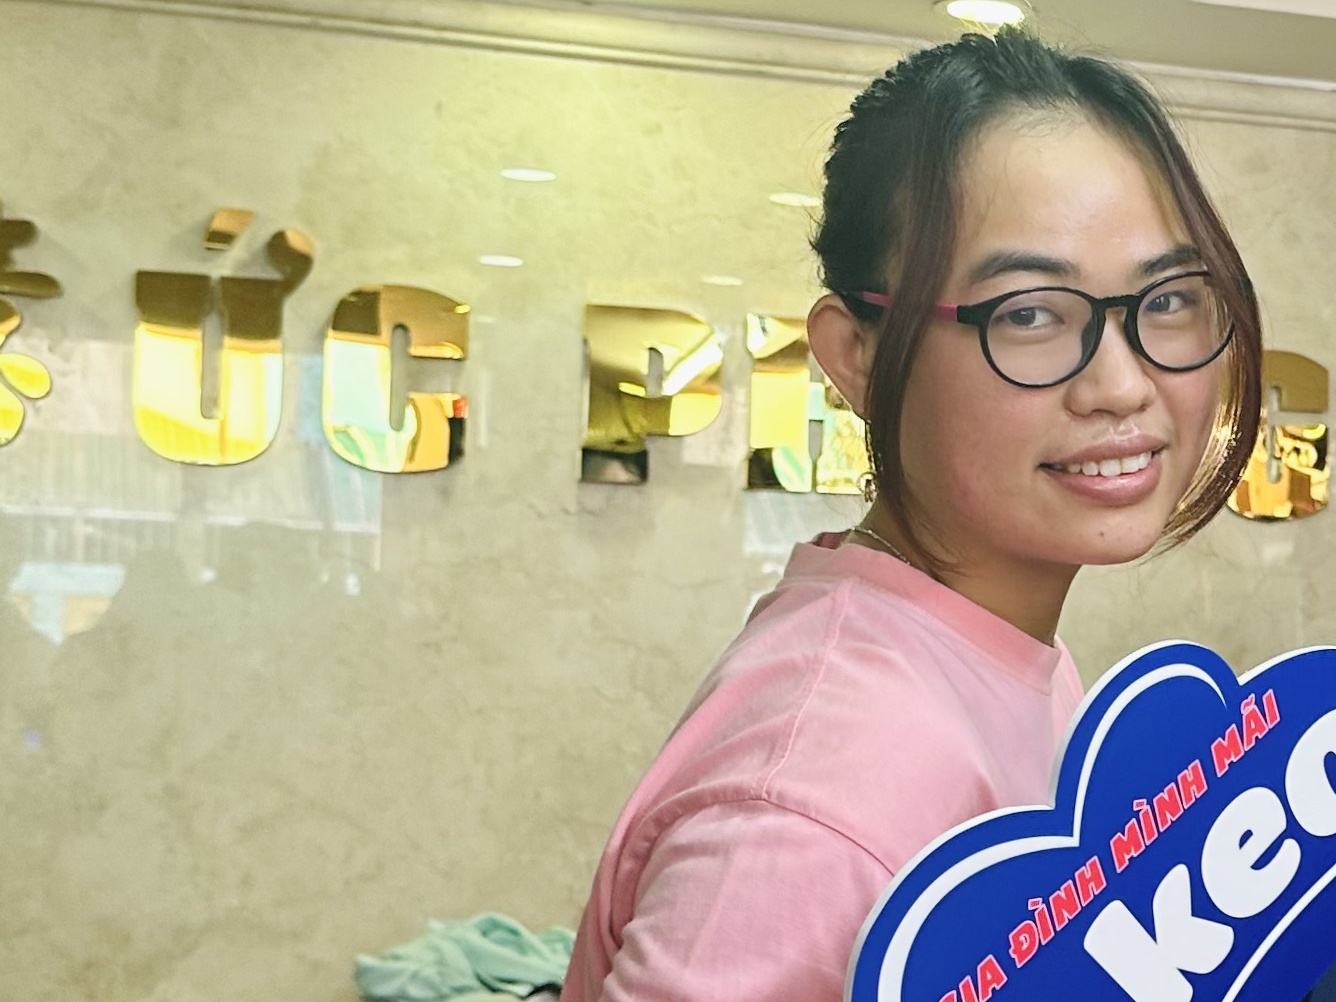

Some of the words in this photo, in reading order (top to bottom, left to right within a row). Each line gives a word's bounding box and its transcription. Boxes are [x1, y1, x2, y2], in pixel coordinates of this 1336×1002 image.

[1008, 857, 1108, 970] ĐÌNH
[1110, 765, 1209, 875] MÌNH
[1211, 687, 1283, 778] MÃI
